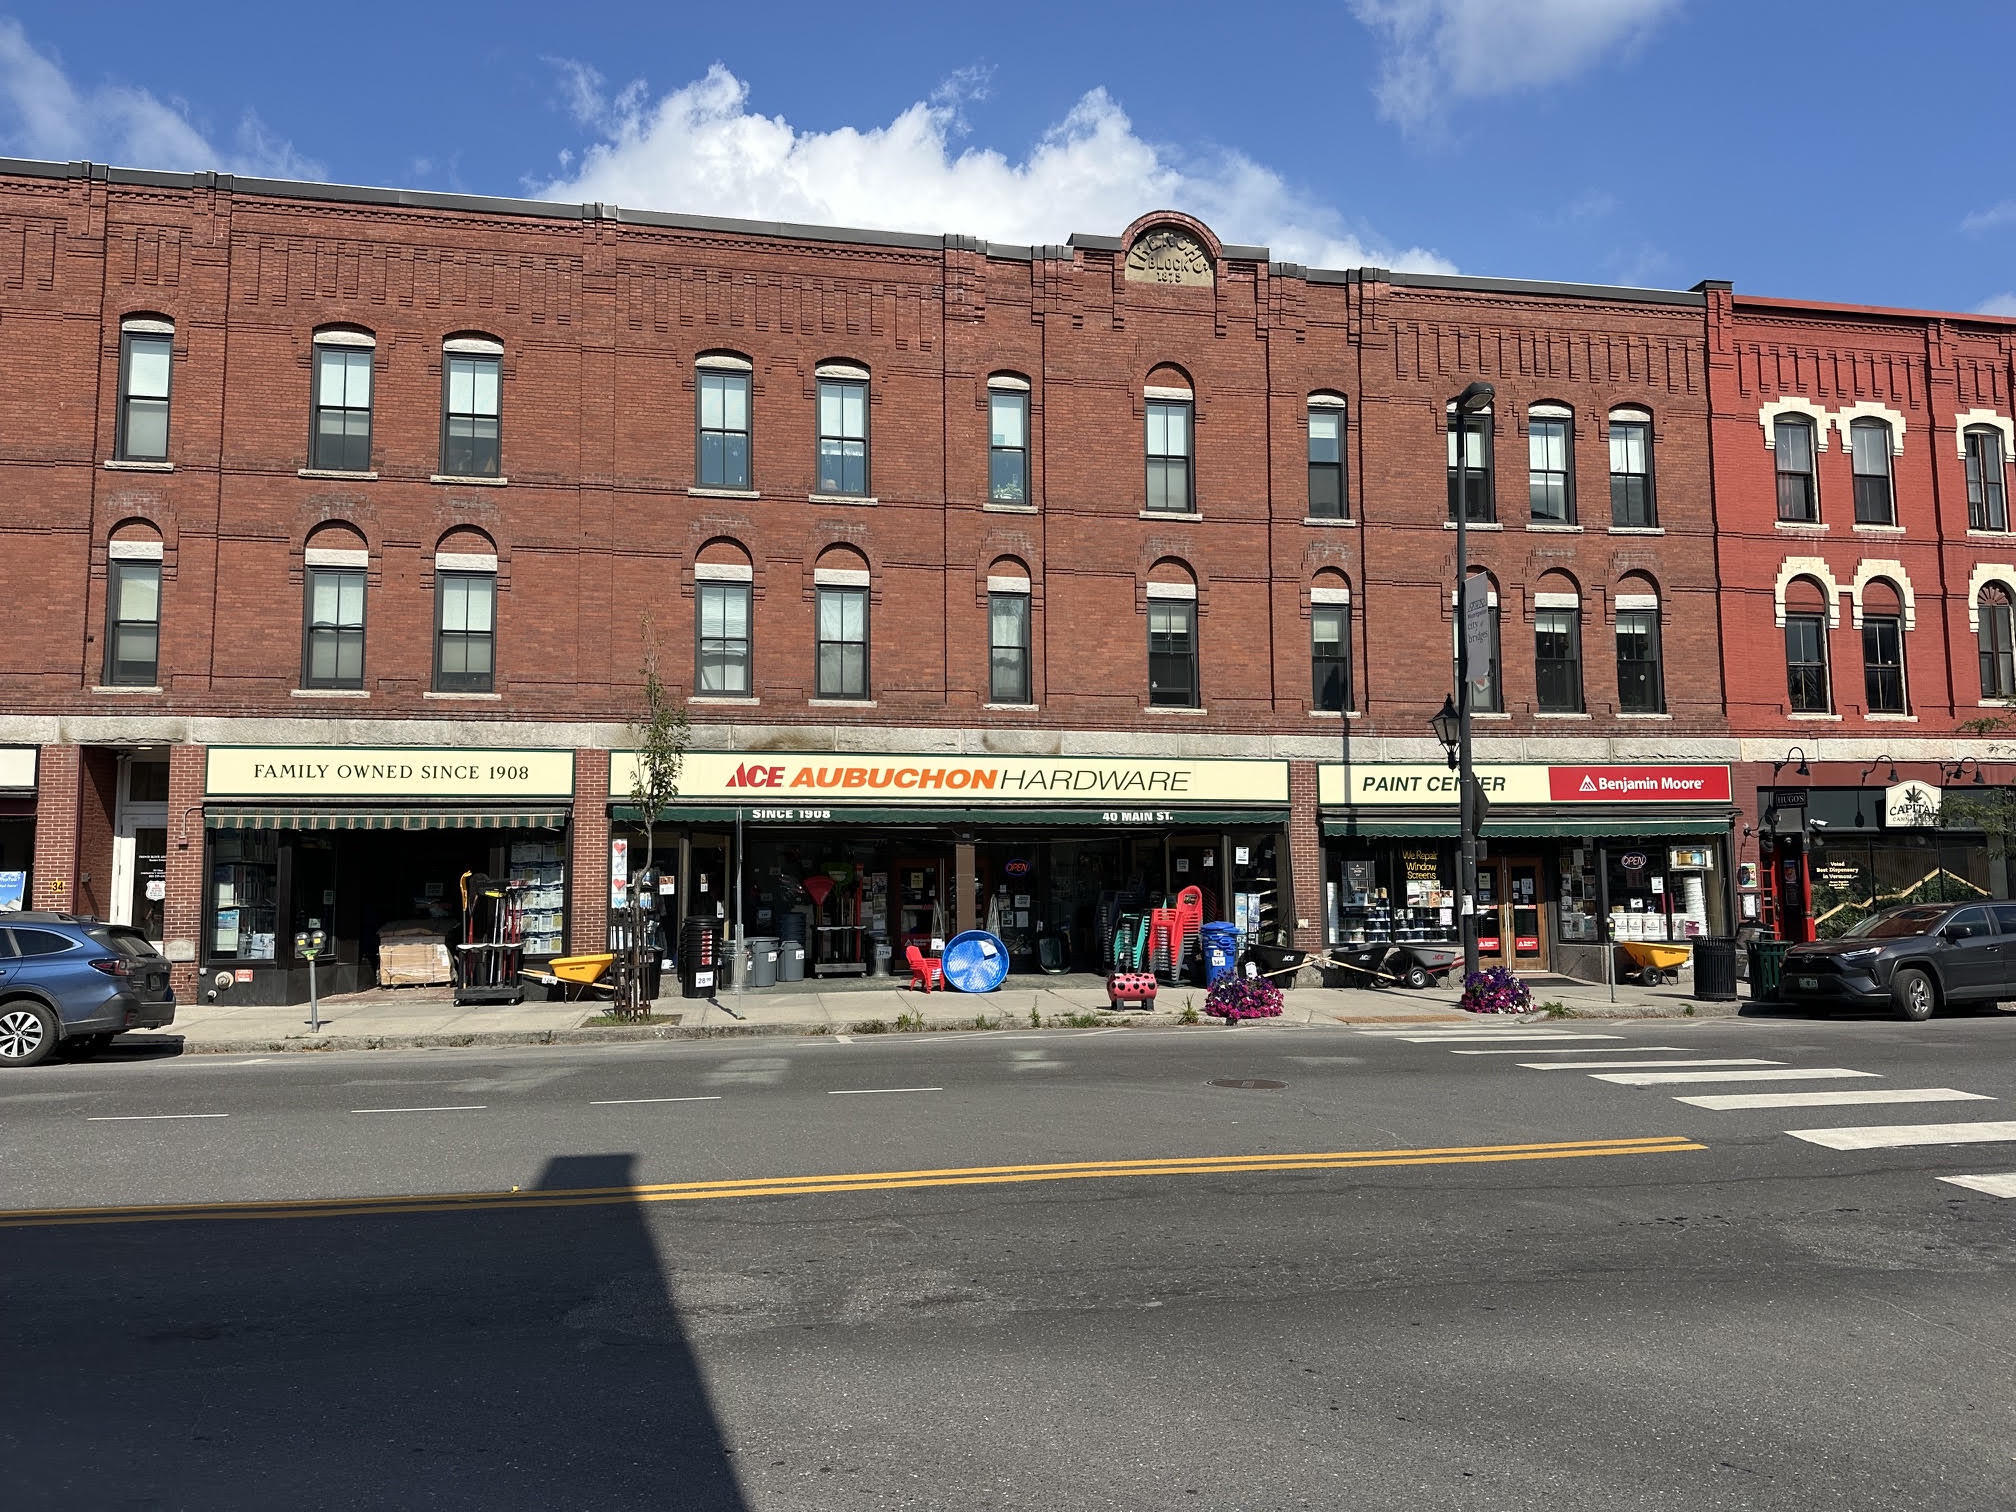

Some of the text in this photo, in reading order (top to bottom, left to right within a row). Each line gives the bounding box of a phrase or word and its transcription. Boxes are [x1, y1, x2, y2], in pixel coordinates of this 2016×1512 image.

[1148, 257, 1189, 273] BLOCK
[254, 764, 530, 780] FAMILY OWNED SINCE 1908
[726, 762, 1192, 792] ACE AUBUCHON HARDWARE
[1362, 776, 1422, 792] PAINT
[1598, 776, 1658, 794] Benjamin
[752, 809, 831, 820] SINCE 1908
[1102, 812, 1174, 822] 40 MAIN ST.
[1402, 850, 1438, 860] We Repair
[1622, 856, 1644, 866] OPEN
[1006, 862, 1028, 873] OPEN
[1406, 862, 1437, 872] Window
[1407, 870, 1437, 880] Screens
[52, 882, 64, 891] 34
